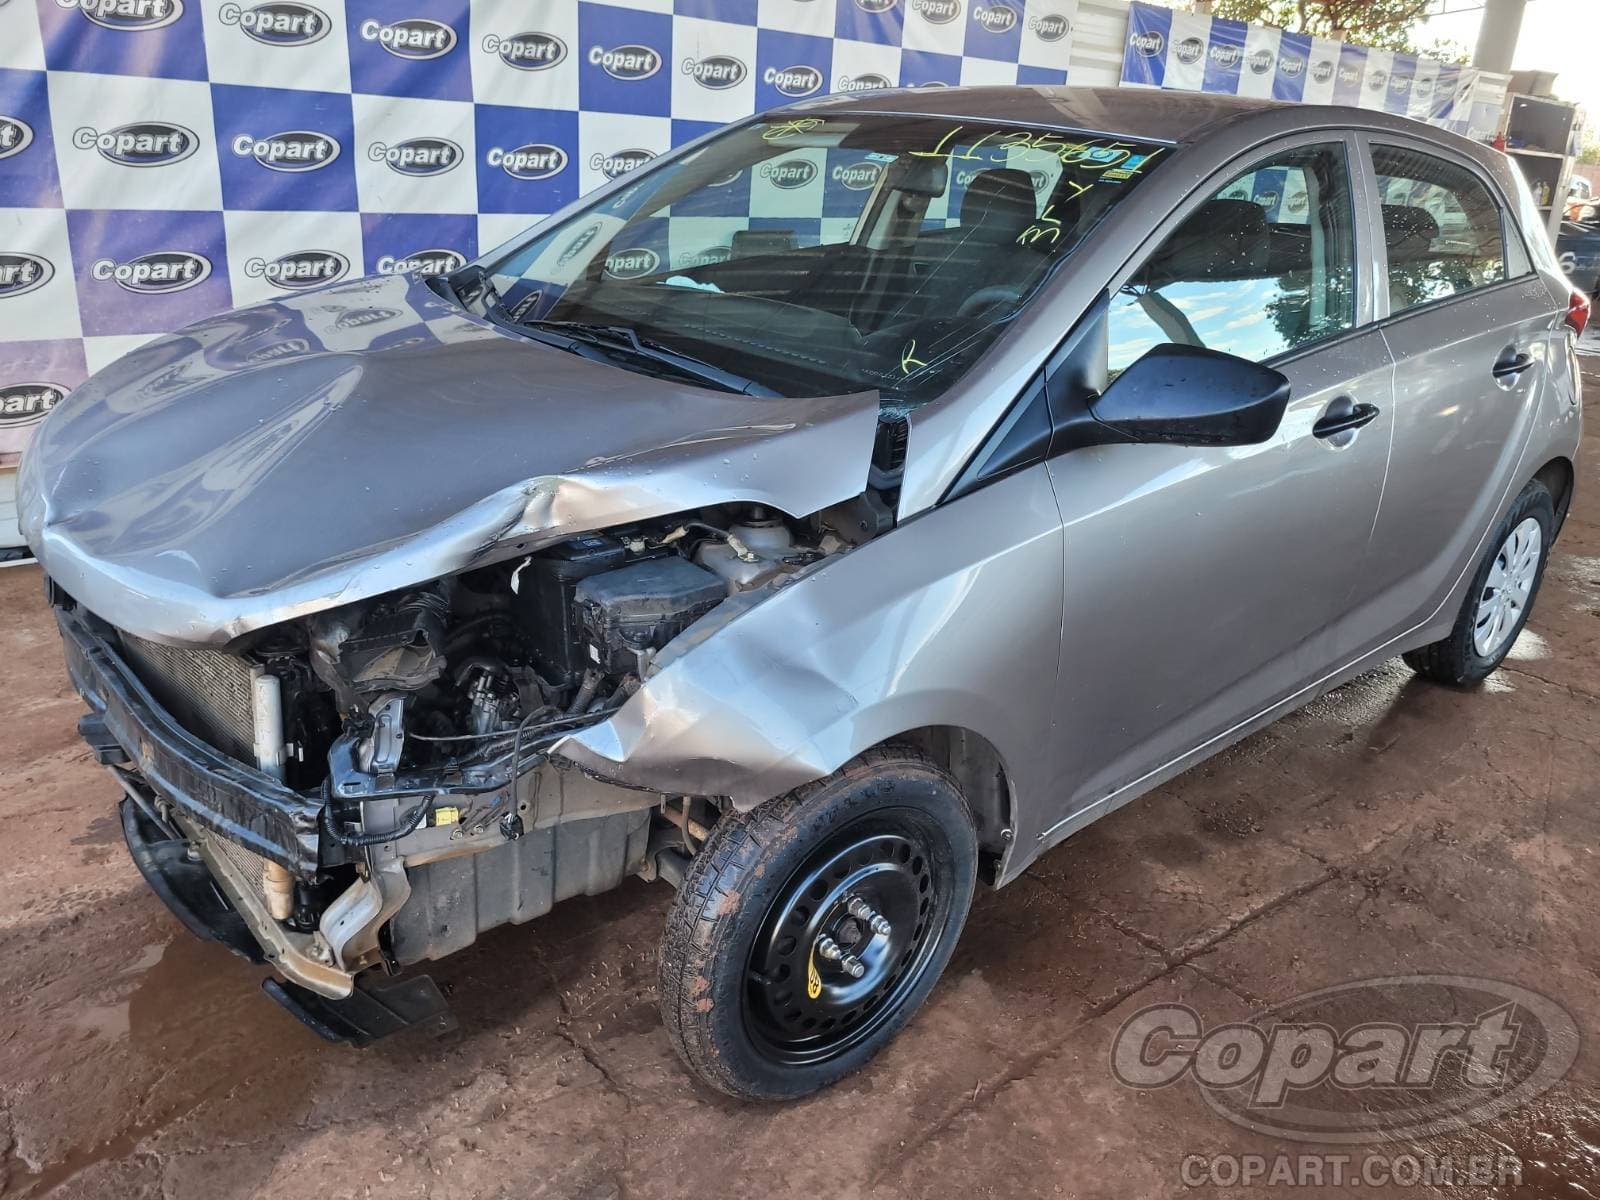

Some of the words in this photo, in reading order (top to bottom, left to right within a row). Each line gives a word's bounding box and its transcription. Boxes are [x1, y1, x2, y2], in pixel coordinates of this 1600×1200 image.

[219, 3, 317, 34] Copart
[973, 6, 1012, 27] Copart
[1028, 16, 1064, 34] Copart
[361, 20, 446, 49] Copart
[1130, 32, 1161, 50] Copart
[481, 34, 556, 62] Copart
[1210, 46, 1237, 62] Copart
[588, 46, 652, 75] Copart
[681, 59, 738, 83] Copart
[764, 67, 816, 91] Copart
[73, 127, 185, 156] Copart
[233, 136, 328, 161] Copart
[368, 142, 452, 165] Copart
[487, 148, 558, 173] Copart
[760, 163, 810, 182] Copart
[832, 165, 877, 183] Copart
[90, 259, 198, 284] Copart
[245, 257, 337, 279] Copart
[605, 254, 650, 272] opart
